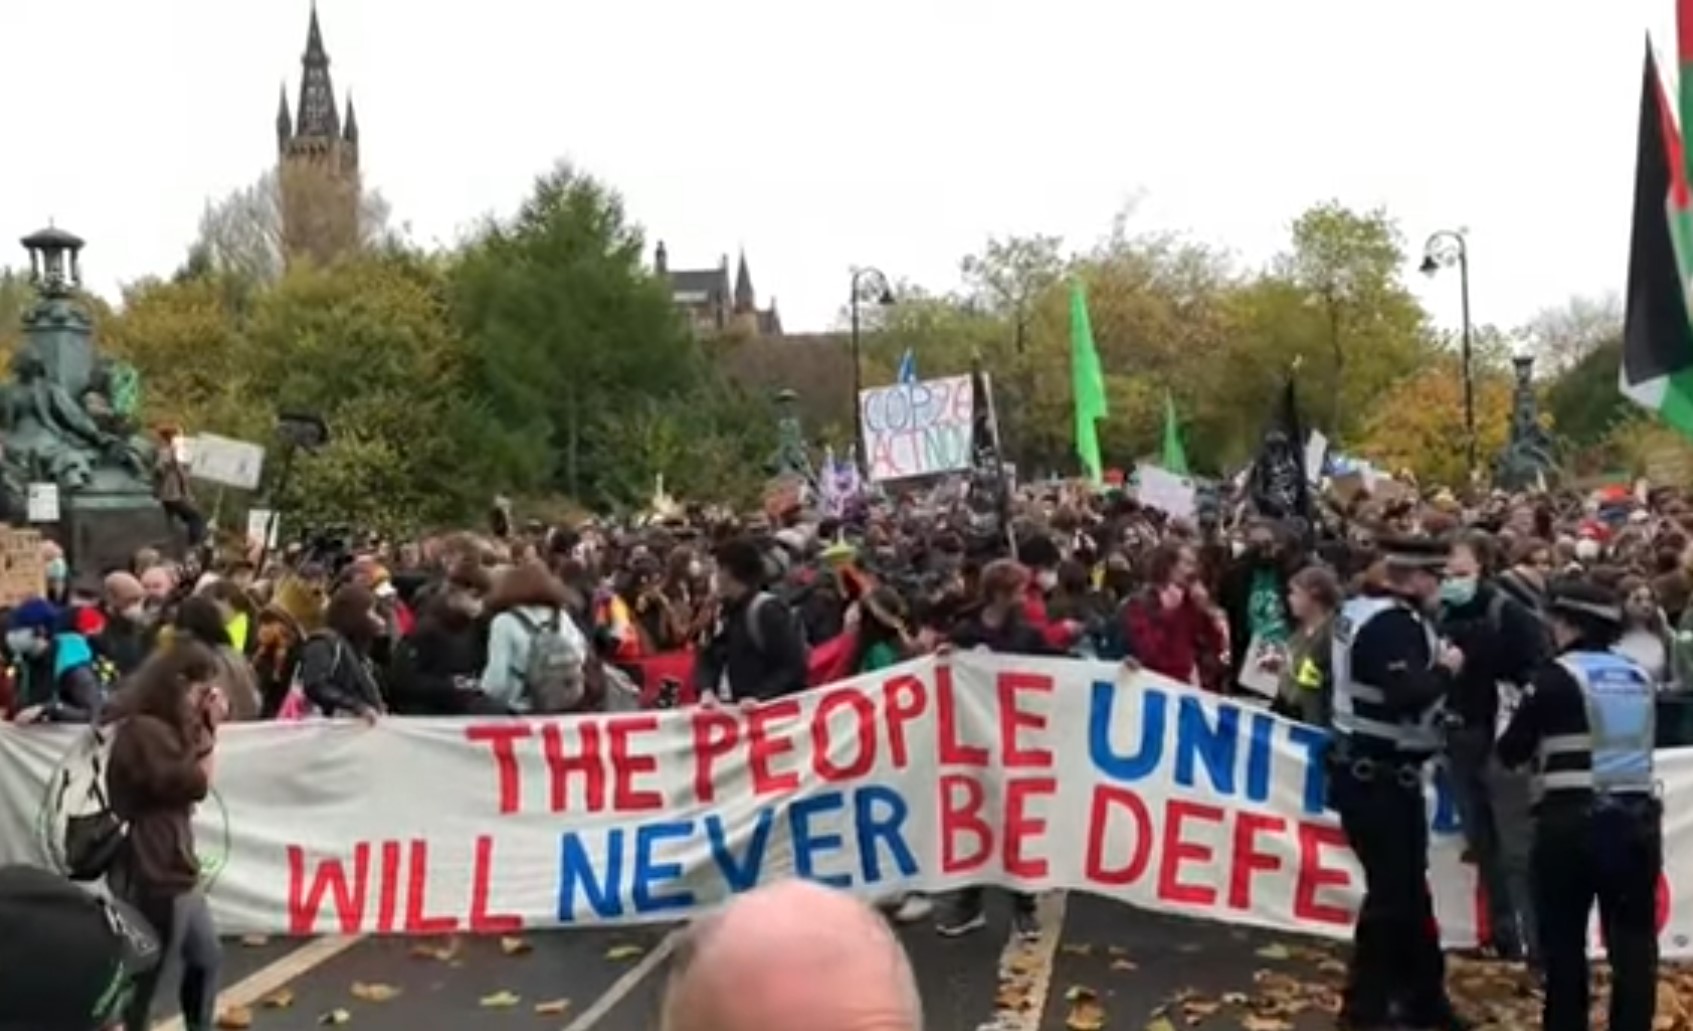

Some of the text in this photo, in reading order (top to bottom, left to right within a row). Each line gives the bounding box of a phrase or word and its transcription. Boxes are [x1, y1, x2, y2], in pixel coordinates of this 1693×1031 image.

[865, 380, 972, 432] COP26
[466, 716, 663, 813] THE
[692, 666, 1053, 802] PEOPLE
[287, 835, 524, 942] WILL
[558, 786, 917, 923] NEVER
[939, 773, 1057, 880] BE
